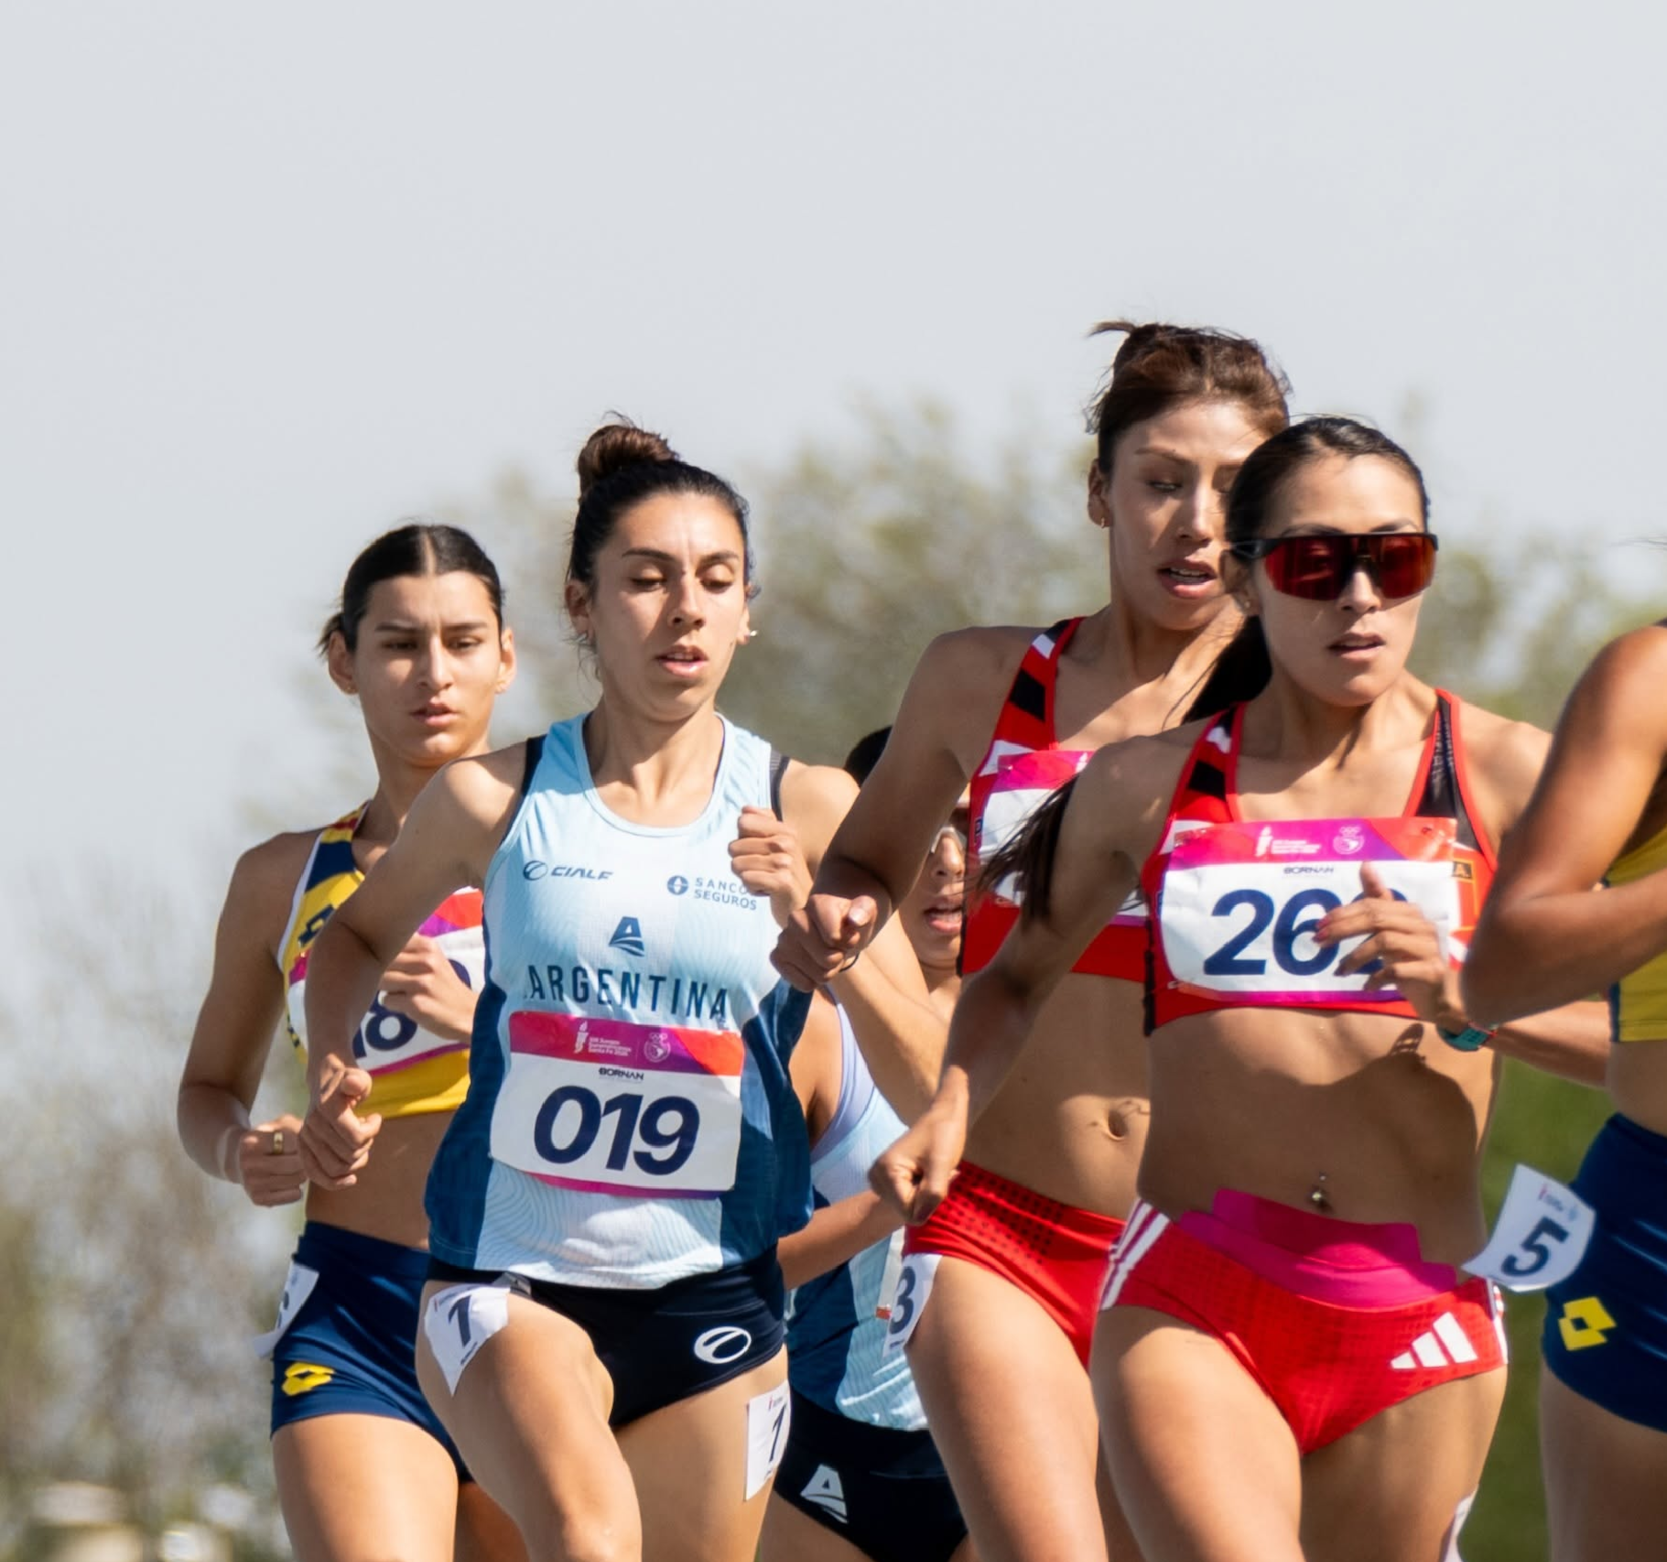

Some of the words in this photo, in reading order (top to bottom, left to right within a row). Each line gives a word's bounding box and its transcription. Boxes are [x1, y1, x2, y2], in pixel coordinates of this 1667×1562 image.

[694, 888, 757, 911] SEGUROS
[695, 877, 749, 896] SANCO
[1203, 888, 1409, 976] 26
[527, 964, 729, 1020] ARGENTINA
[534, 1085, 700, 1176] 019
[1500, 1216, 1570, 1277] 5
[448, 1295, 472, 1348] 1
[889, 1266, 916, 1335] 3
[771, 1402, 788, 1462] 1
